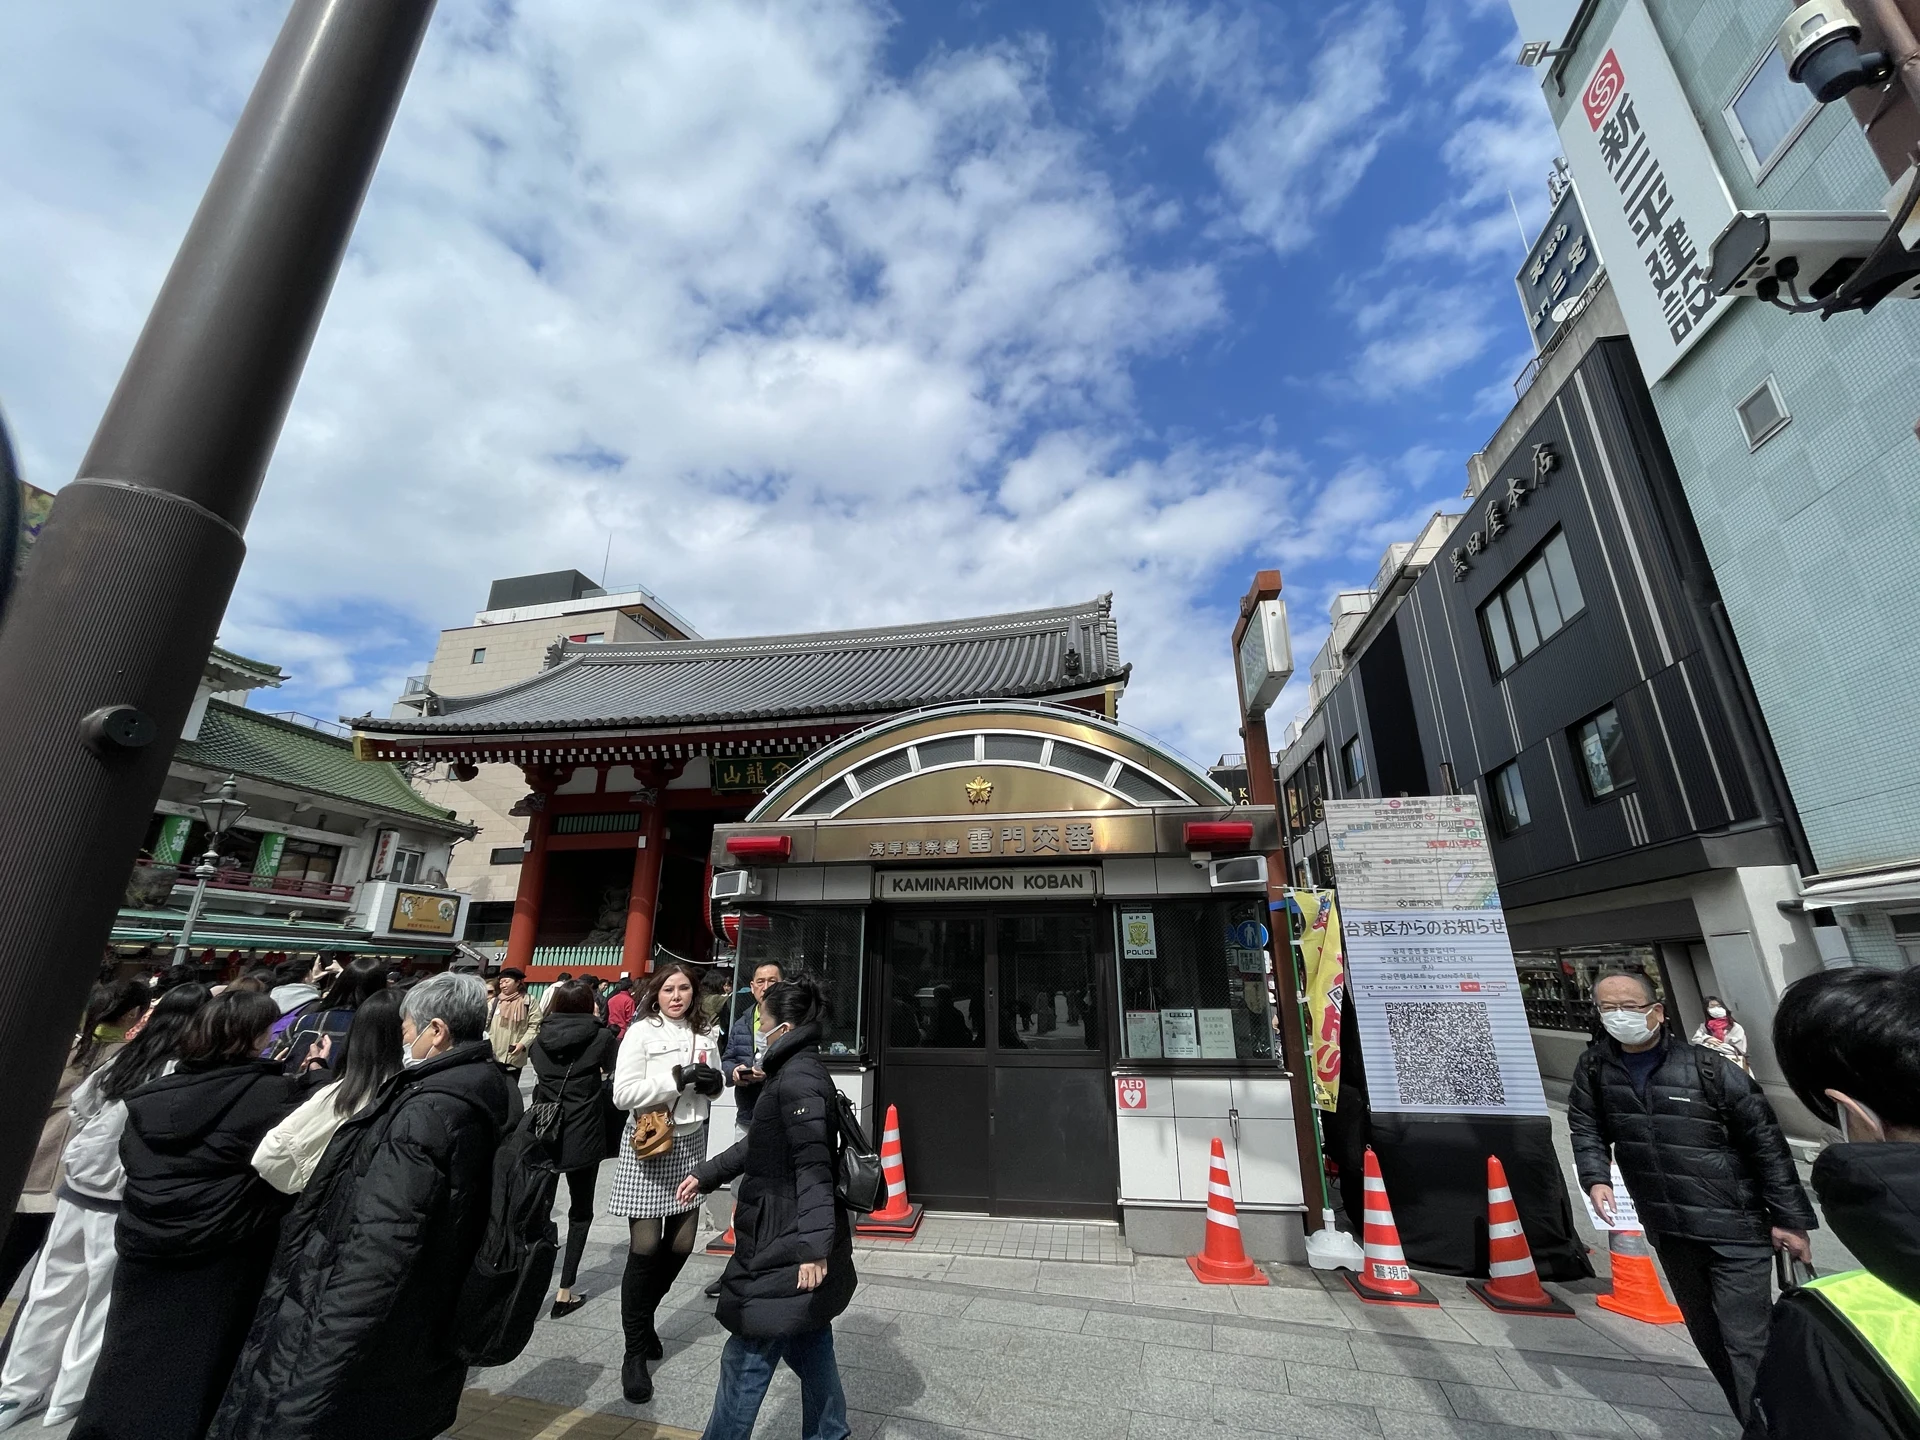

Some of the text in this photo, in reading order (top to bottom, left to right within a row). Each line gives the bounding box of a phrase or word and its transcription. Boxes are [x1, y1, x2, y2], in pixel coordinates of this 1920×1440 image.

[1599, 93, 1717, 347] 新三平建設
[869, 823, 1094, 857] 浅草警察署 雷門交番
[893, 874, 1083, 892] KAMINARIMON KOBAN
[1344, 919, 1505, 937] 台東区からのお知らせ
[1120, 1080, 1144, 1089] AED
